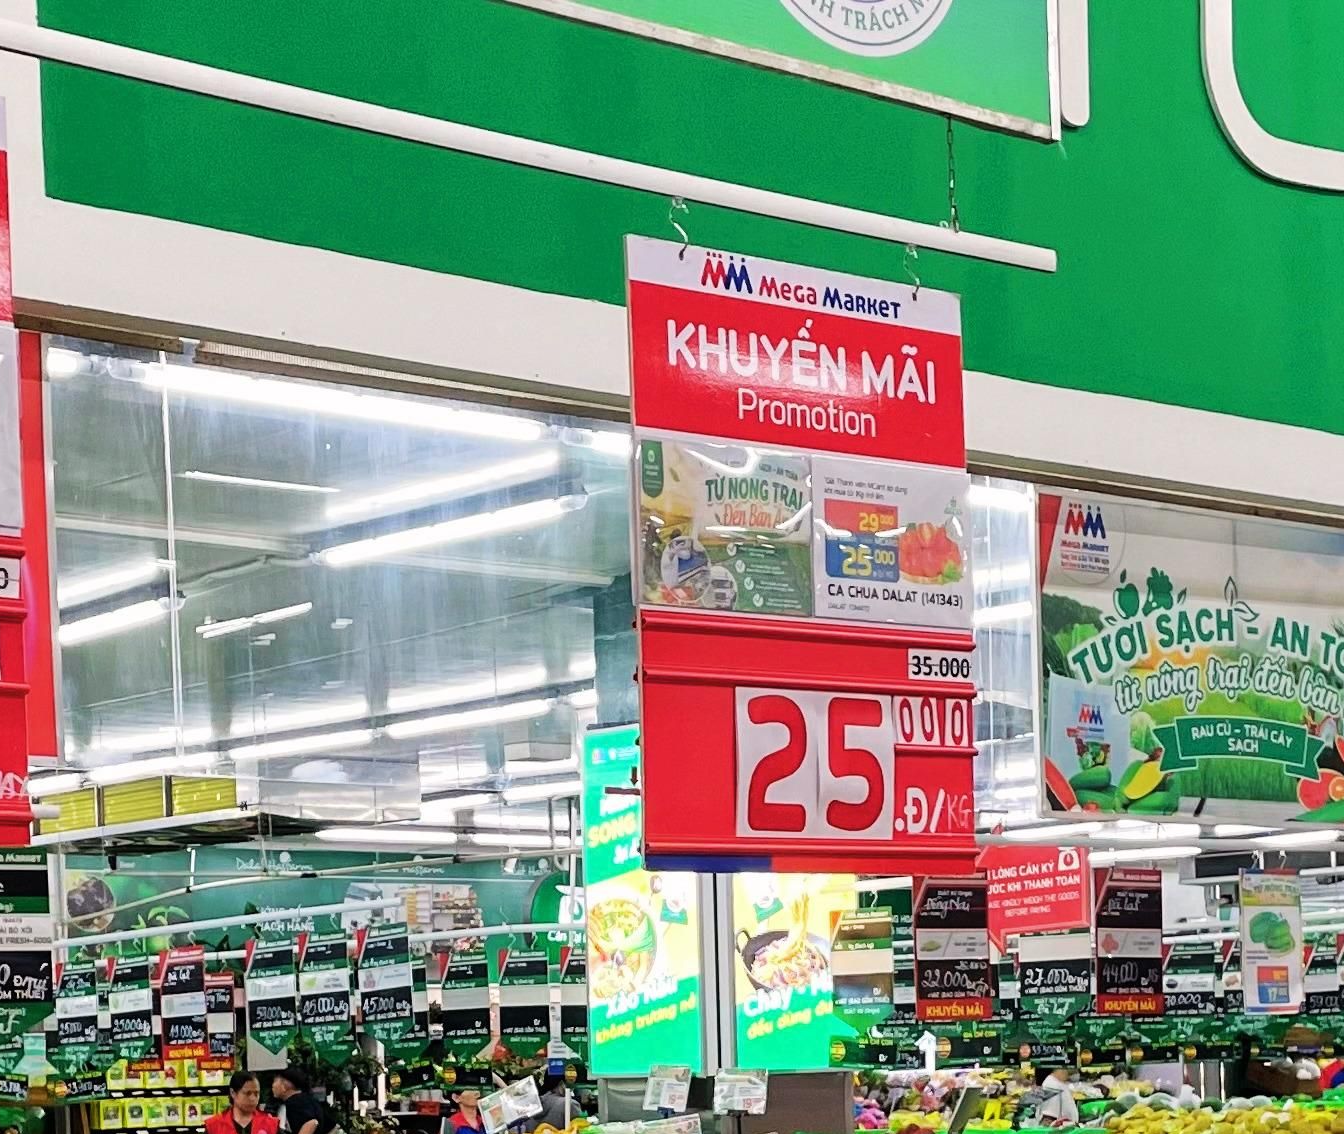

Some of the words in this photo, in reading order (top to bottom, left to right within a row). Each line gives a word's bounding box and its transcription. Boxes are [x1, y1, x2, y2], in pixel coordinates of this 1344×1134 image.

[666, 318, 848, 393] KHUYẾN
[862, 345, 936, 404] MÃI
[738, 388, 877, 438] Promotion
[848, 585, 879, 599] CHUA
[882, 588, 917, 603] DALAT
[1071, 624, 1148, 684] TƯƠI
[1158, 608, 1235, 653] SẠCH
[1270, 615, 1310, 658] AN
[911, 654, 971, 679] 35.000
[1146, 662, 1202, 712] nông
[1254, 656, 1296, 697] đến
[1191, 723, 1215, 740] RAU
[1244, 723, 1267, 742] TRÁI
[1269, 728, 1293, 749] CÂY
[1227, 737, 1259, 756] SẠCH
[746, 694, 885, 832] 25
[1007, 881, 1021, 892] KHI
[1023, 878, 1053, 890] THANH
[926, 1001, 964, 1017] KHUYẾN
[967, 1002, 984, 1016] MÃI
[1105, 999, 1137, 1011] KHUYẾN
[1139, 999, 1156, 1011] MÃI
